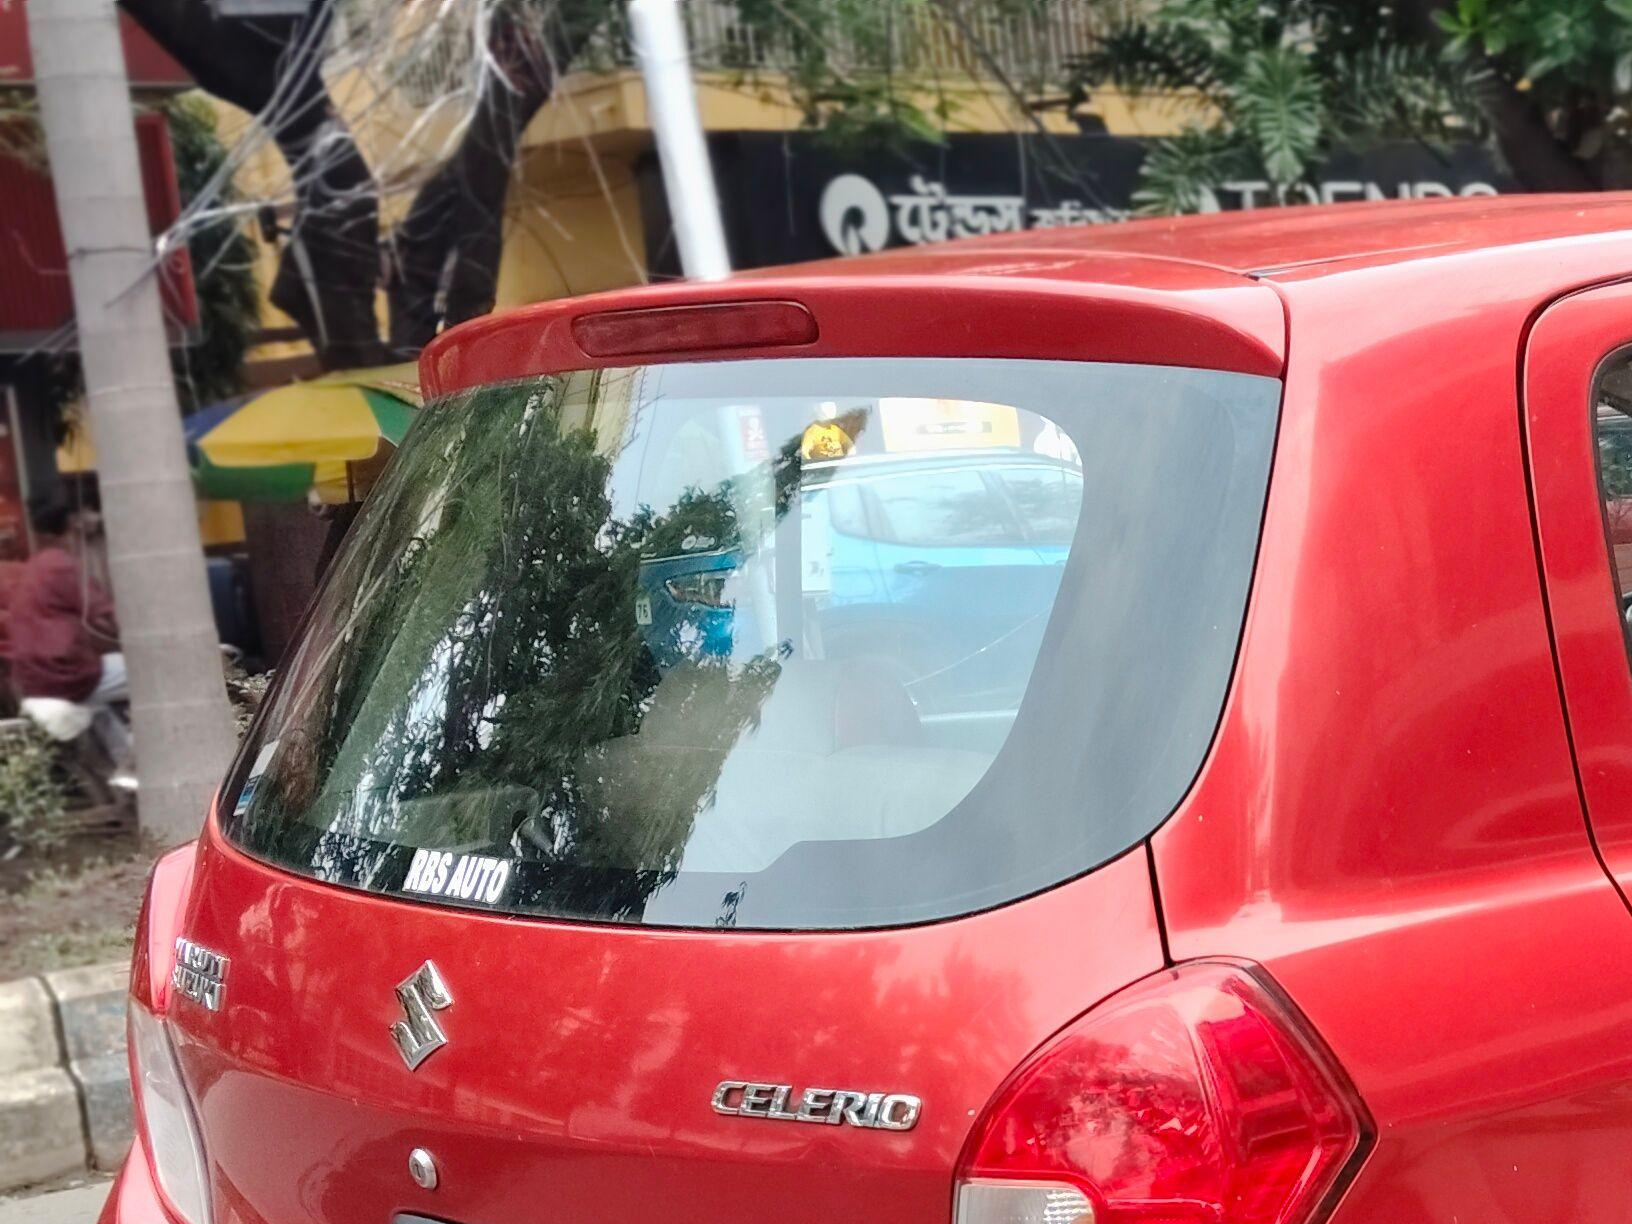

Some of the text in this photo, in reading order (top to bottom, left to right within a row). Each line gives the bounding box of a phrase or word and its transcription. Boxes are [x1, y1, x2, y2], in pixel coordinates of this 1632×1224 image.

[401, 847, 510, 904] RBS AUTO
[710, 1079, 923, 1131] CELERIO
